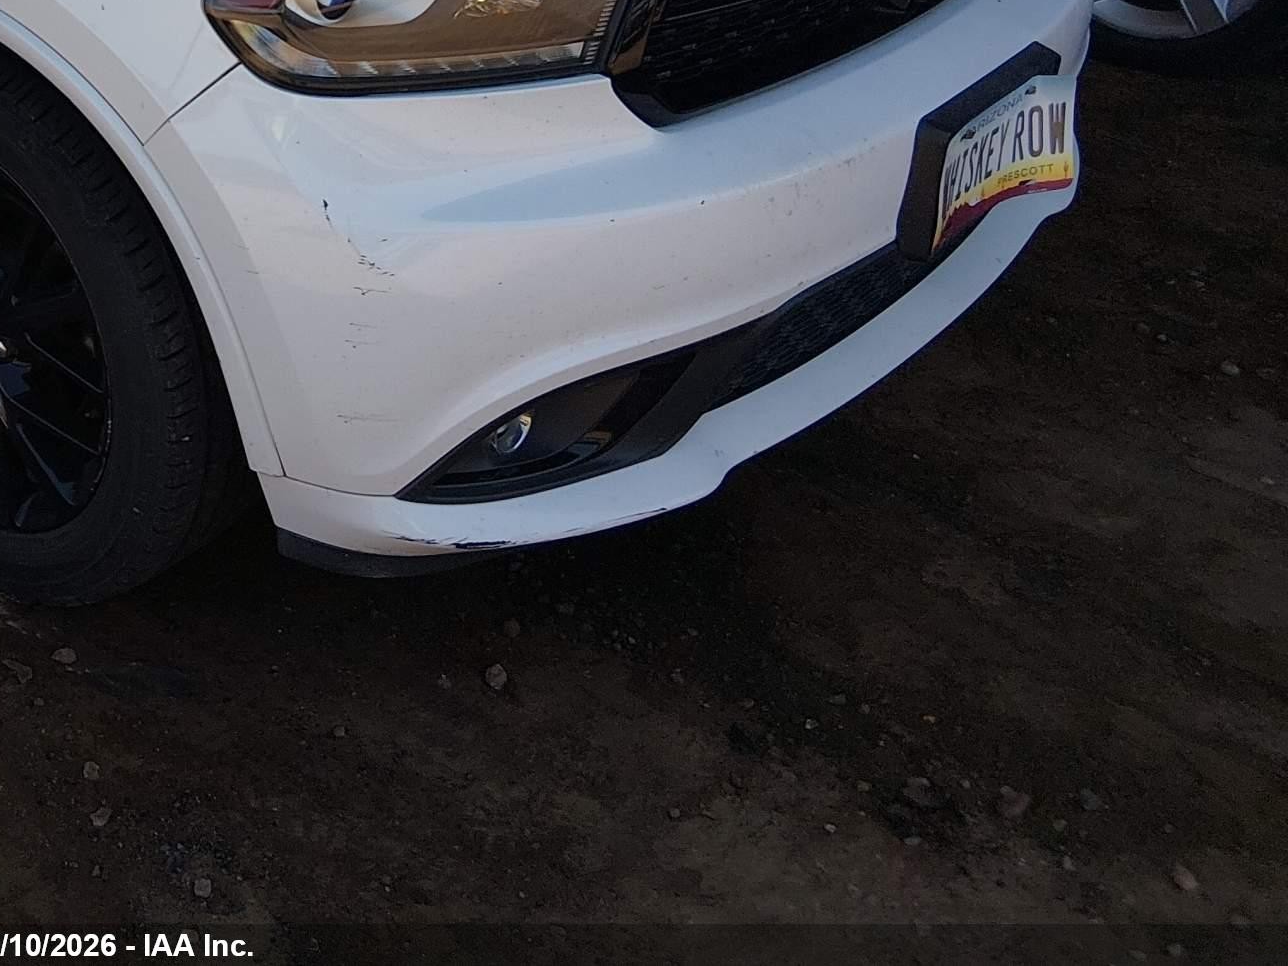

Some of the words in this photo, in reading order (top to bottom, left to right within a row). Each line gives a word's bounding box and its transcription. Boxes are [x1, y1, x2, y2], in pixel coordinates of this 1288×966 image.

[942, 118, 1011, 220] WHISKEY
[1011, 101, 1066, 163] ROW
[997, 163, 1054, 187] PRESCOTT
